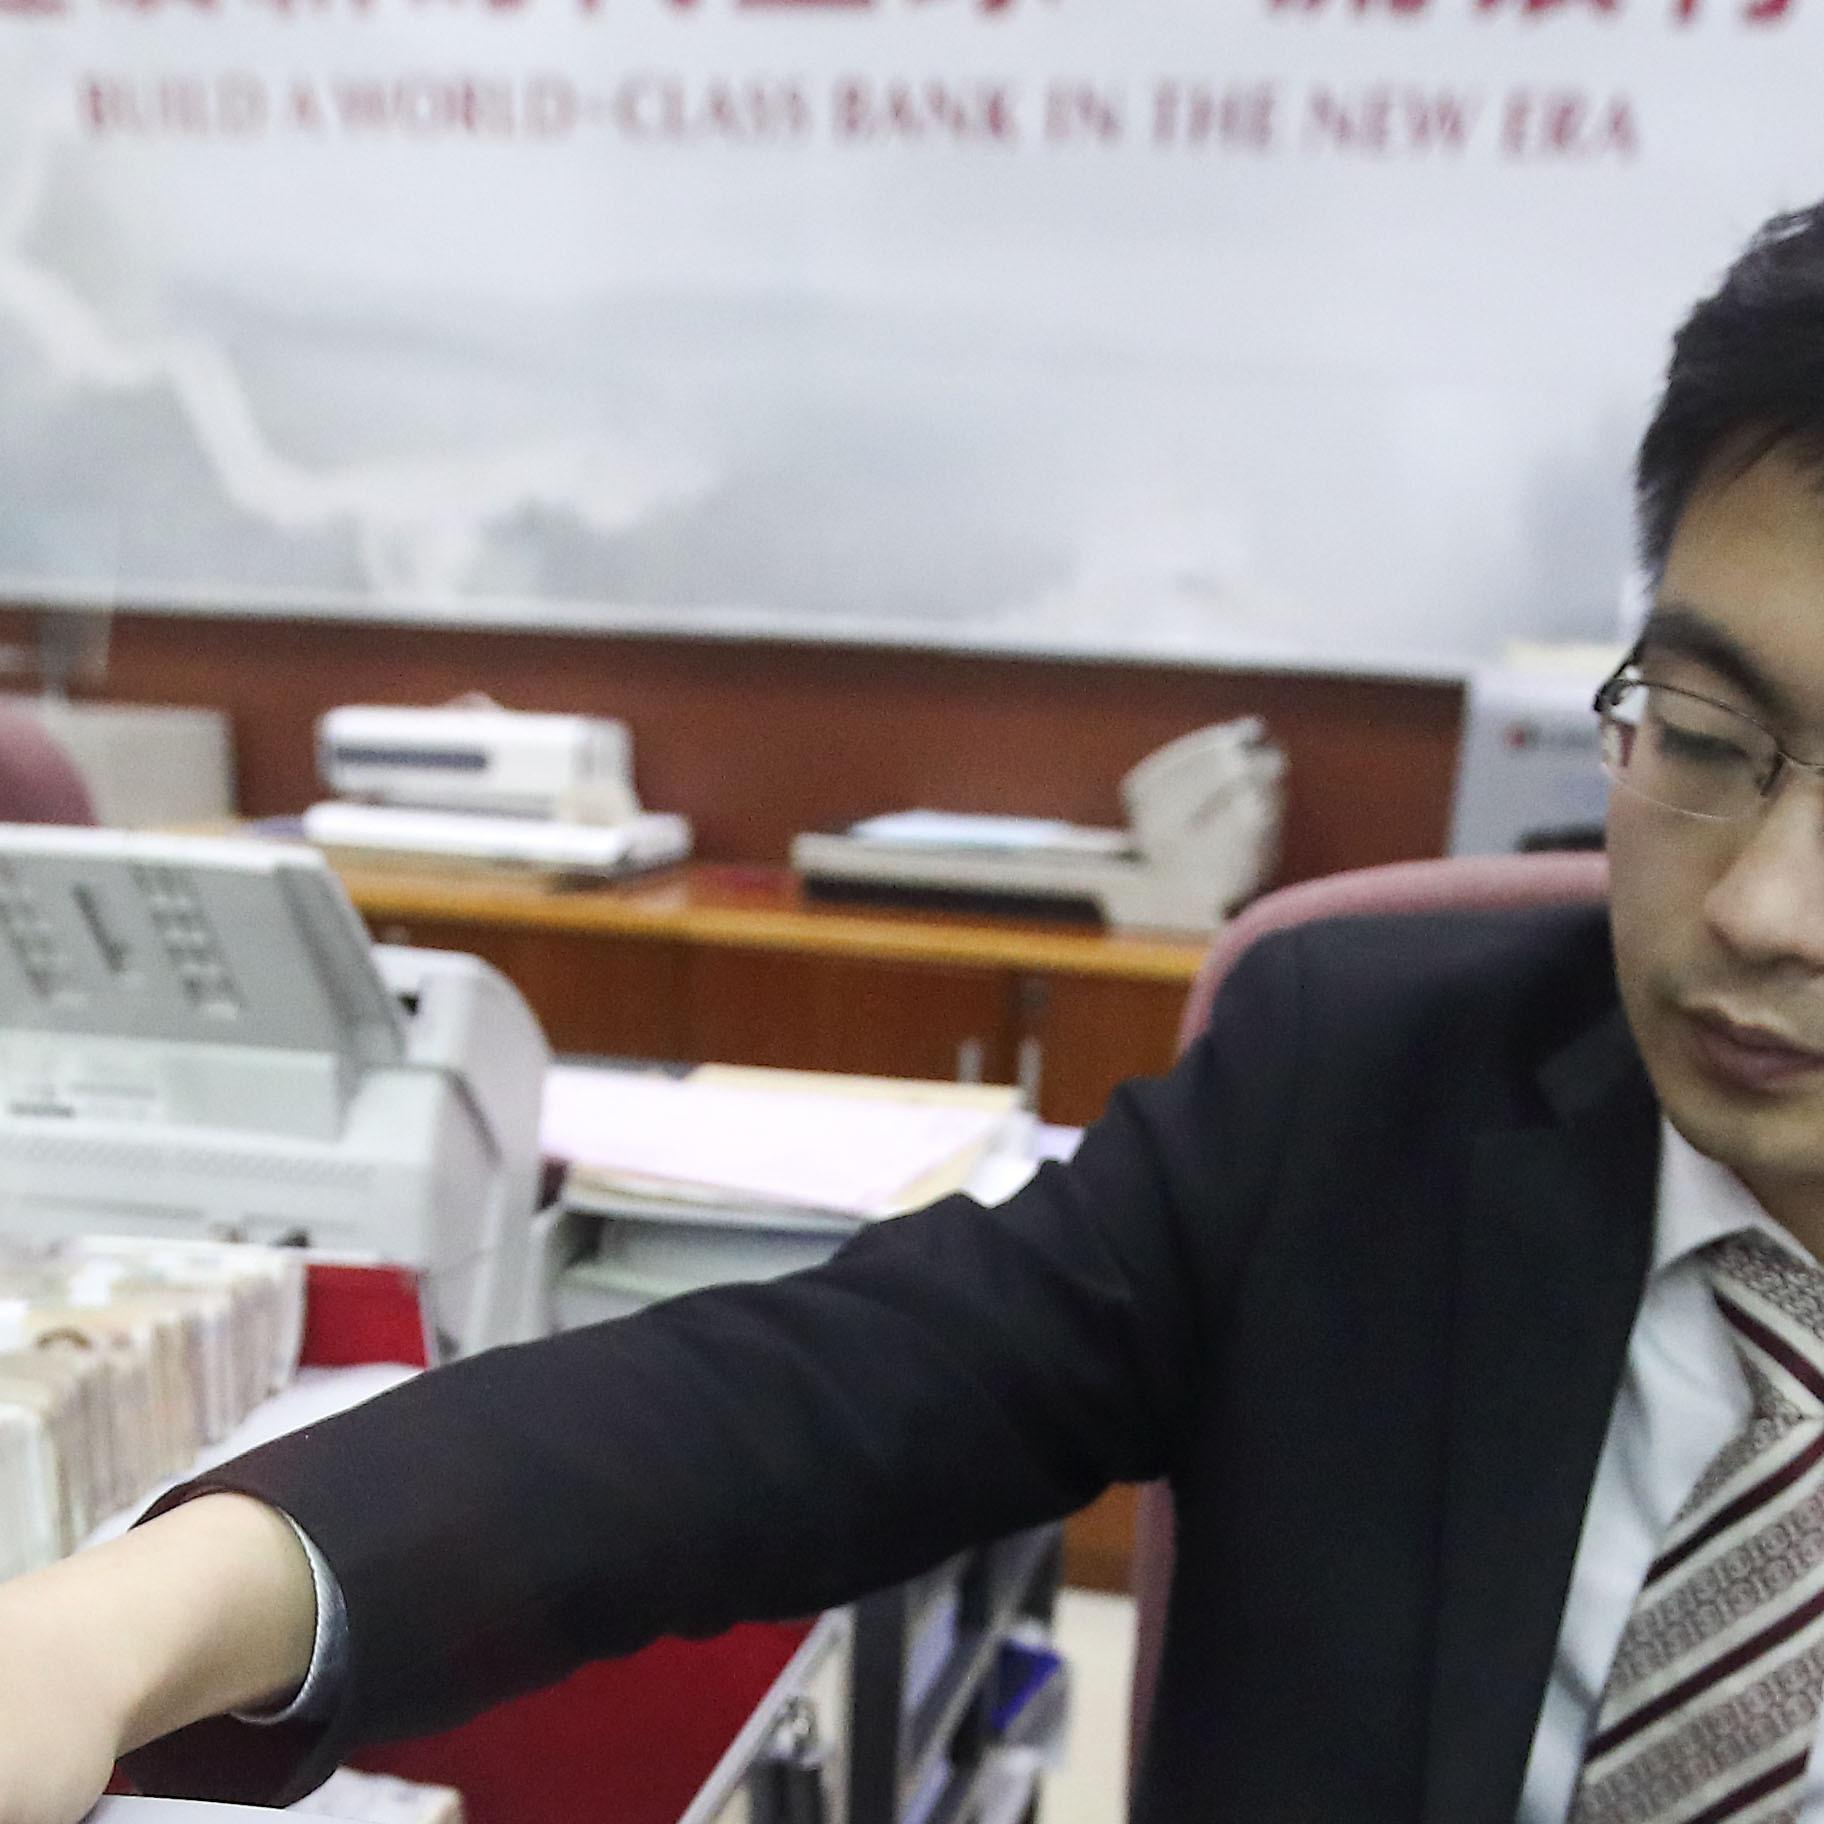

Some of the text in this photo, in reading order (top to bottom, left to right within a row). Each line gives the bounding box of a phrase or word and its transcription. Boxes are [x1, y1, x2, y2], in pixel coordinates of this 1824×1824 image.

[76, 74, 268, 142] BUILD
[323, 74, 816, 148] WORLD-CLASS
[830, 77, 1022, 148] BANK
[1044, 78, 1124, 150] IN
[1148, 82, 1276, 154] THE
[1298, 85, 1474, 158] NEW
[1498, 92, 1640, 162] ERA
